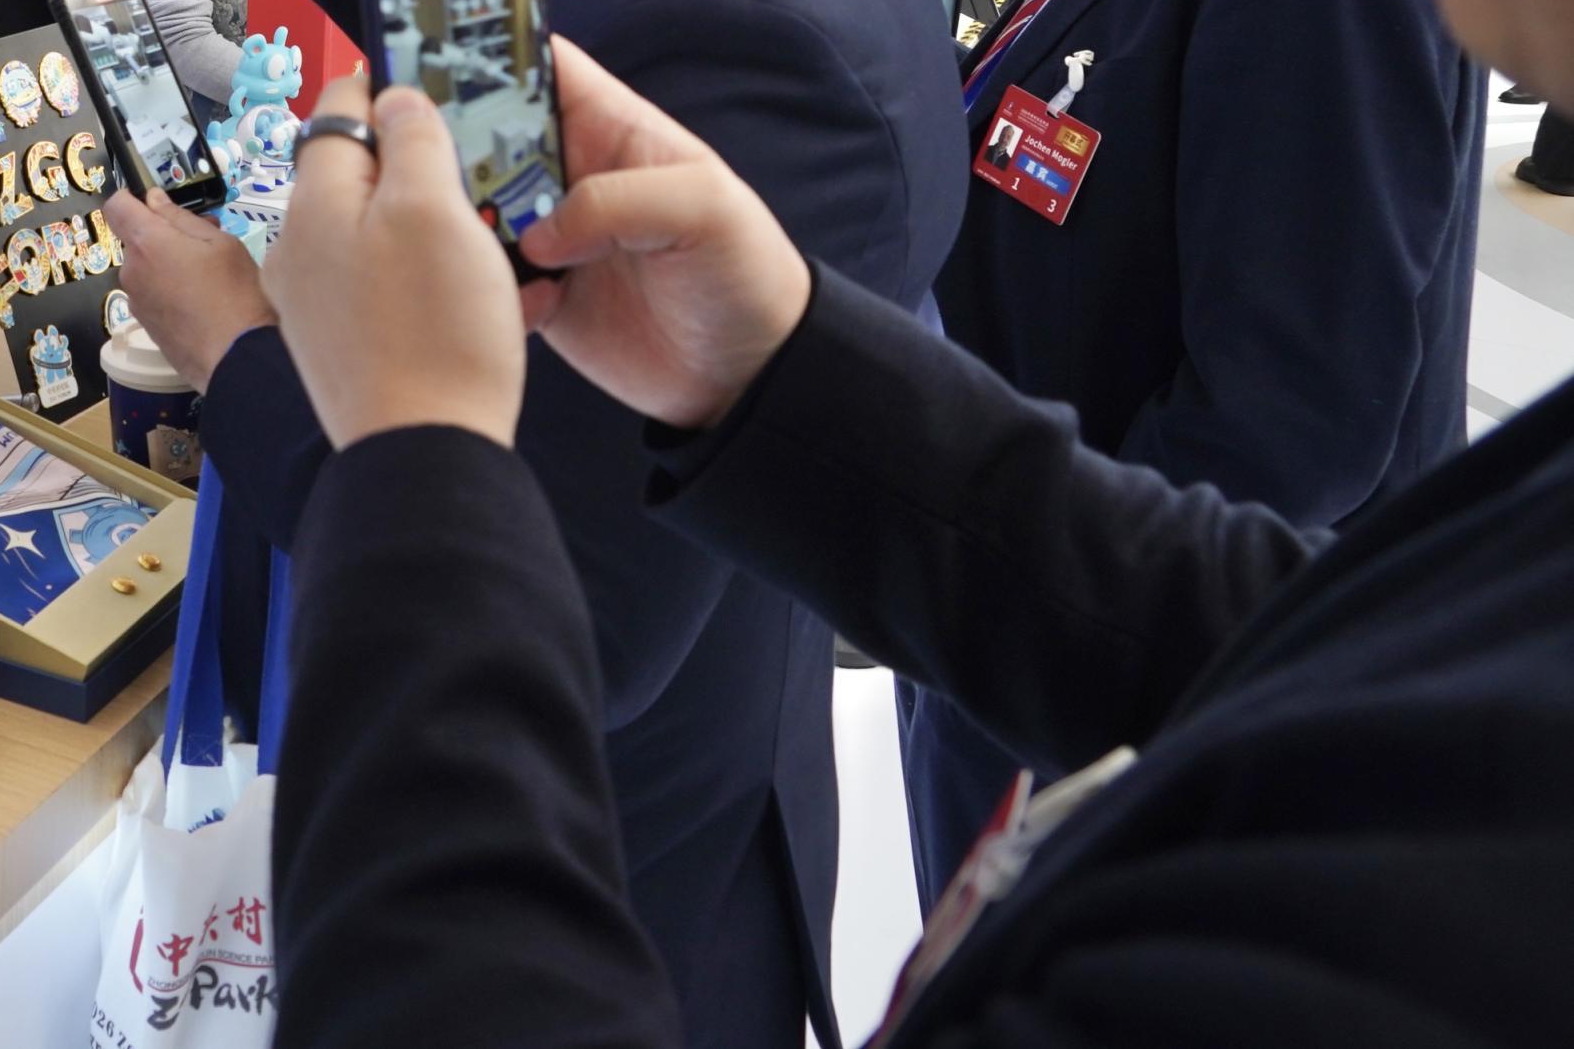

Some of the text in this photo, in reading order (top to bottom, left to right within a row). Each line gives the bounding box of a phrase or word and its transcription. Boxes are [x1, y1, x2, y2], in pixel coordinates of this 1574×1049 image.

[1024, 135, 1052, 156] Jochen
[1050, 149, 1078, 170] Mogler
[1011, 177, 1021, 191] 1
[1047, 199, 1058, 213] 3
